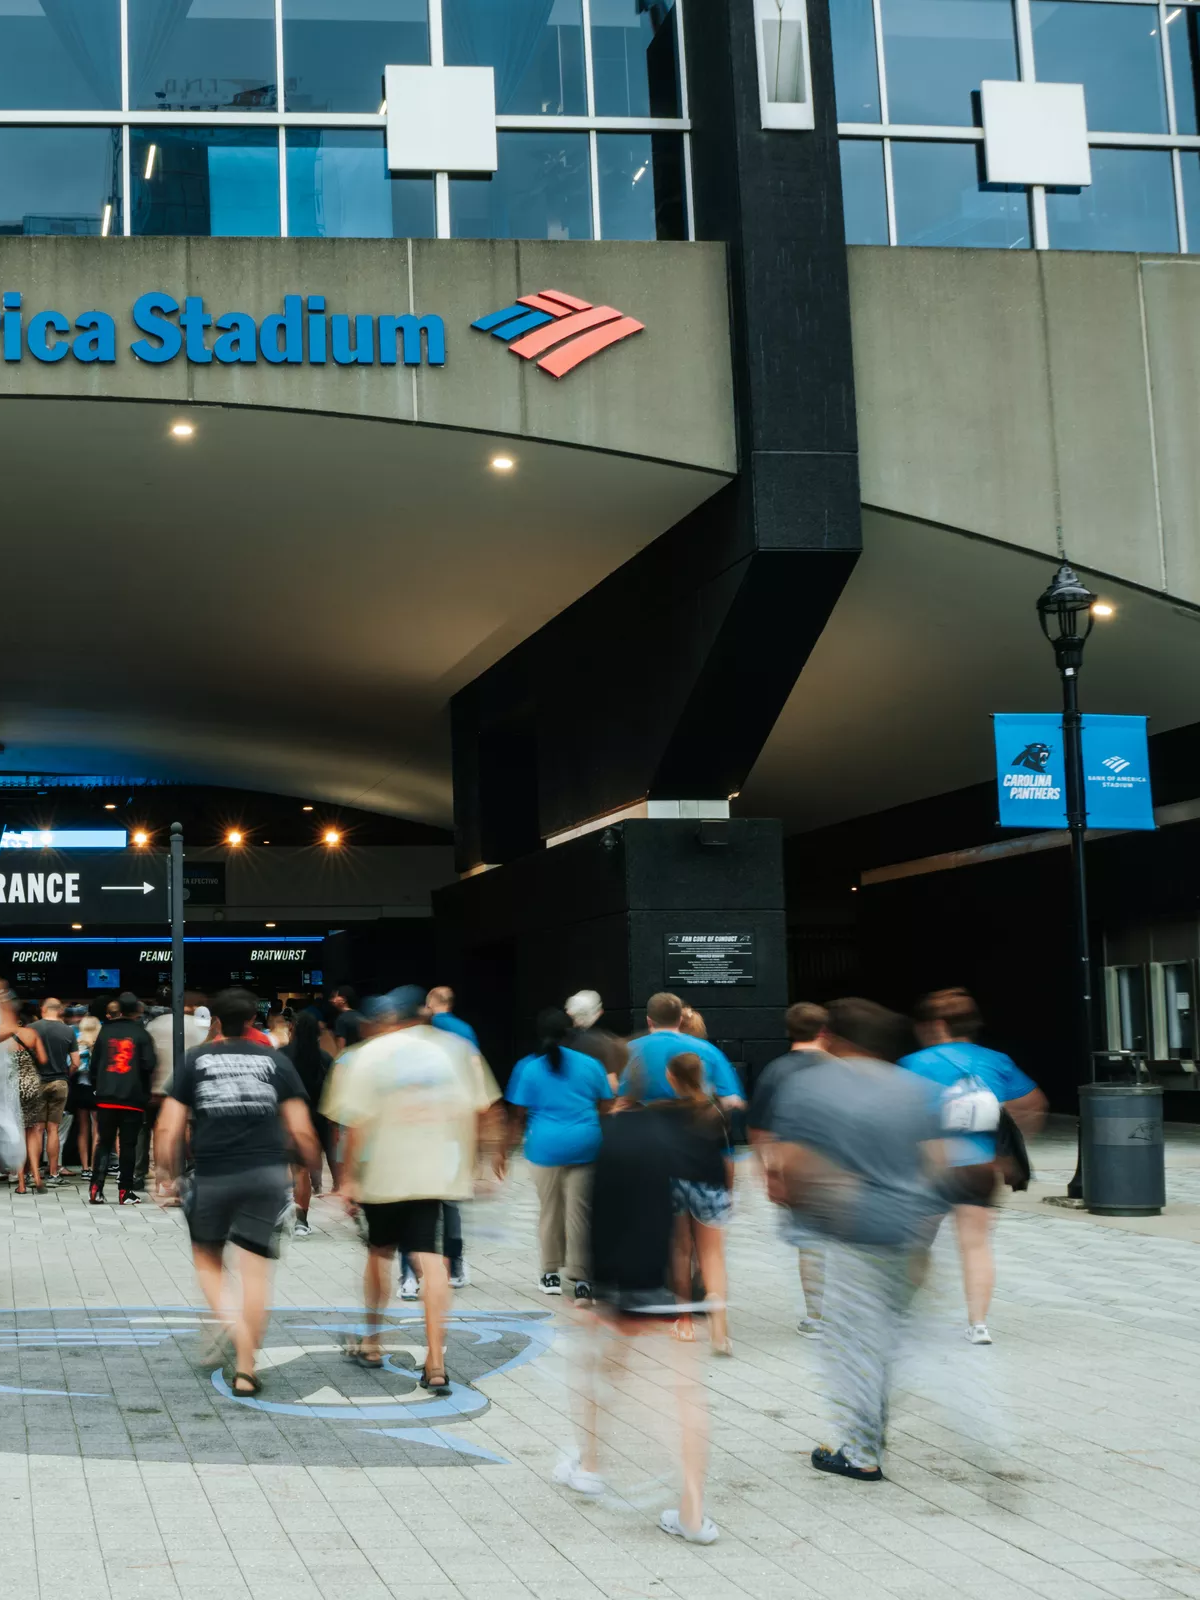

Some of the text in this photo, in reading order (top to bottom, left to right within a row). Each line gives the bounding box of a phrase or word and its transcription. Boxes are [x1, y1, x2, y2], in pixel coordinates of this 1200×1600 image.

[131, 291, 446, 367] Stadium
[1003, 774, 1052, 787] CAROLINA
[1009, 787, 1061, 800] PANTHERS
[12, 951, 58, 963] POPCORN
[250, 949, 307, 961] BRATWURST
